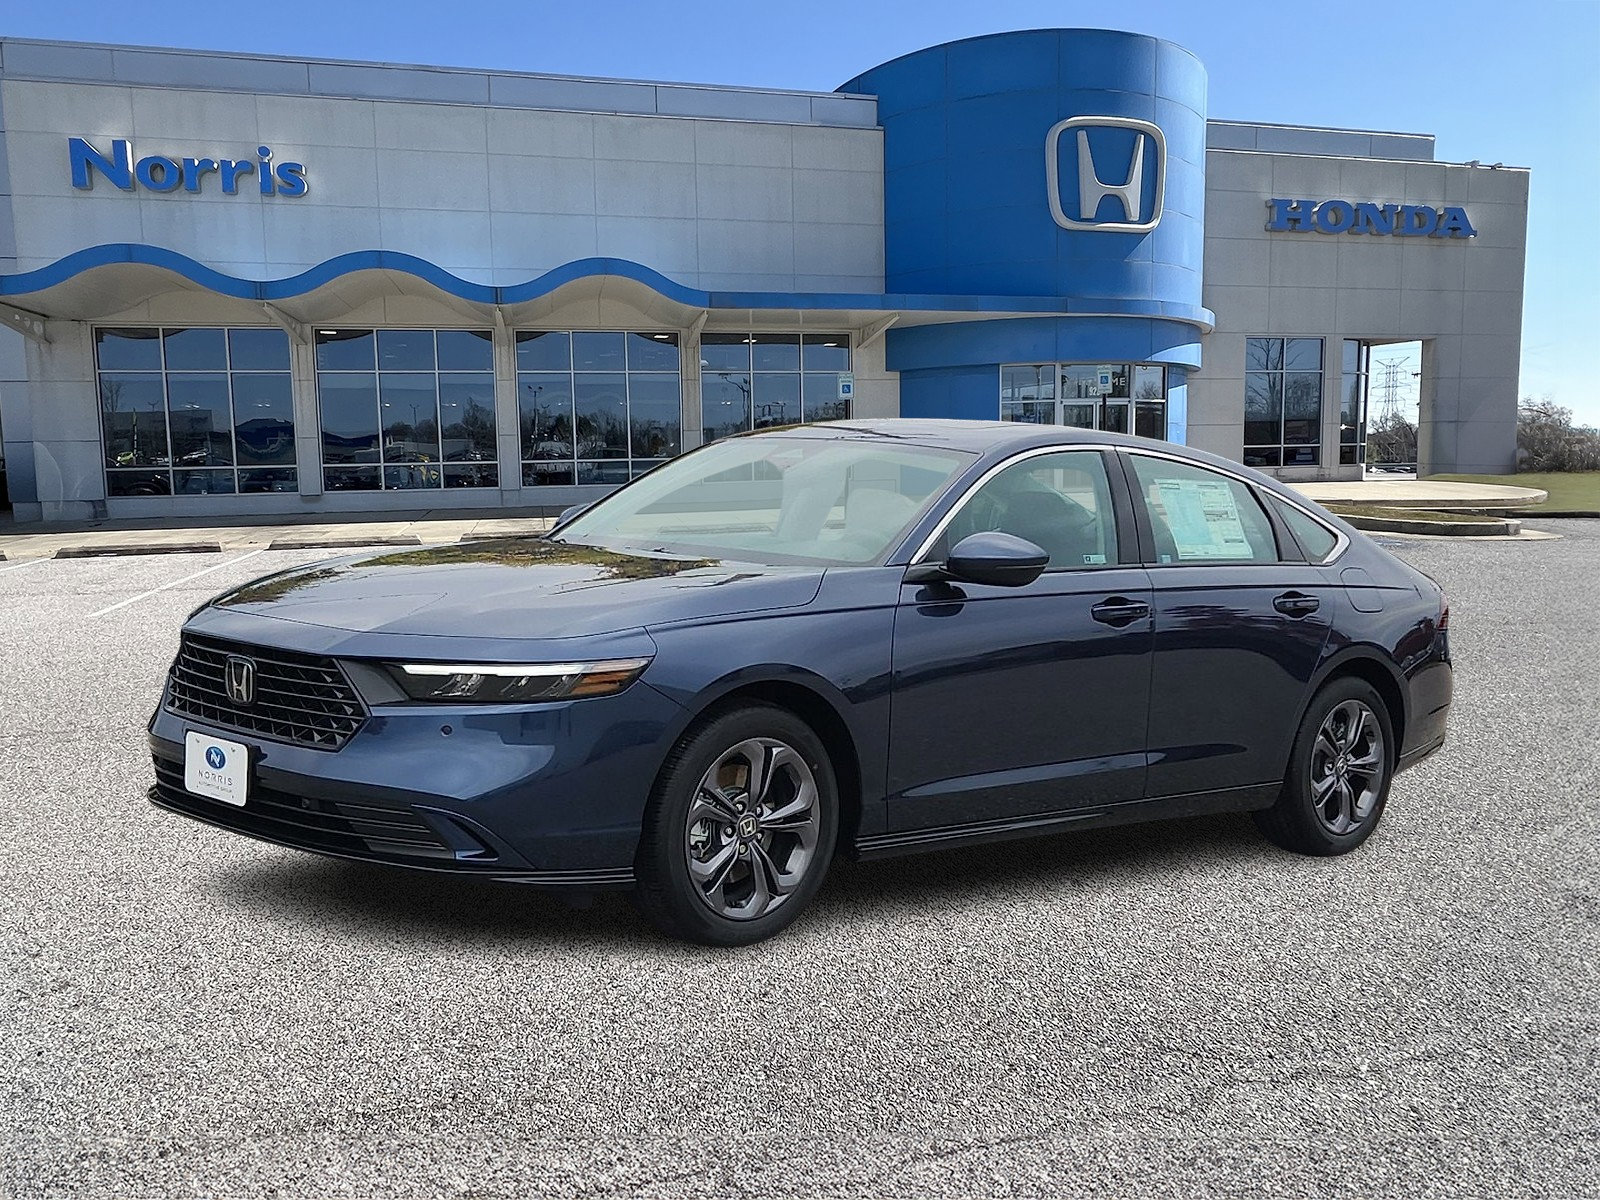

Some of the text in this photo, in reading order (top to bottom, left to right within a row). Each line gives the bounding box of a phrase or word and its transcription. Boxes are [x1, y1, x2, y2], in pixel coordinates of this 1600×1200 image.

[68, 137, 309, 197] Norris
[1266, 198, 1477, 238] HONDA
[198, 769, 233, 786] NORRIS
